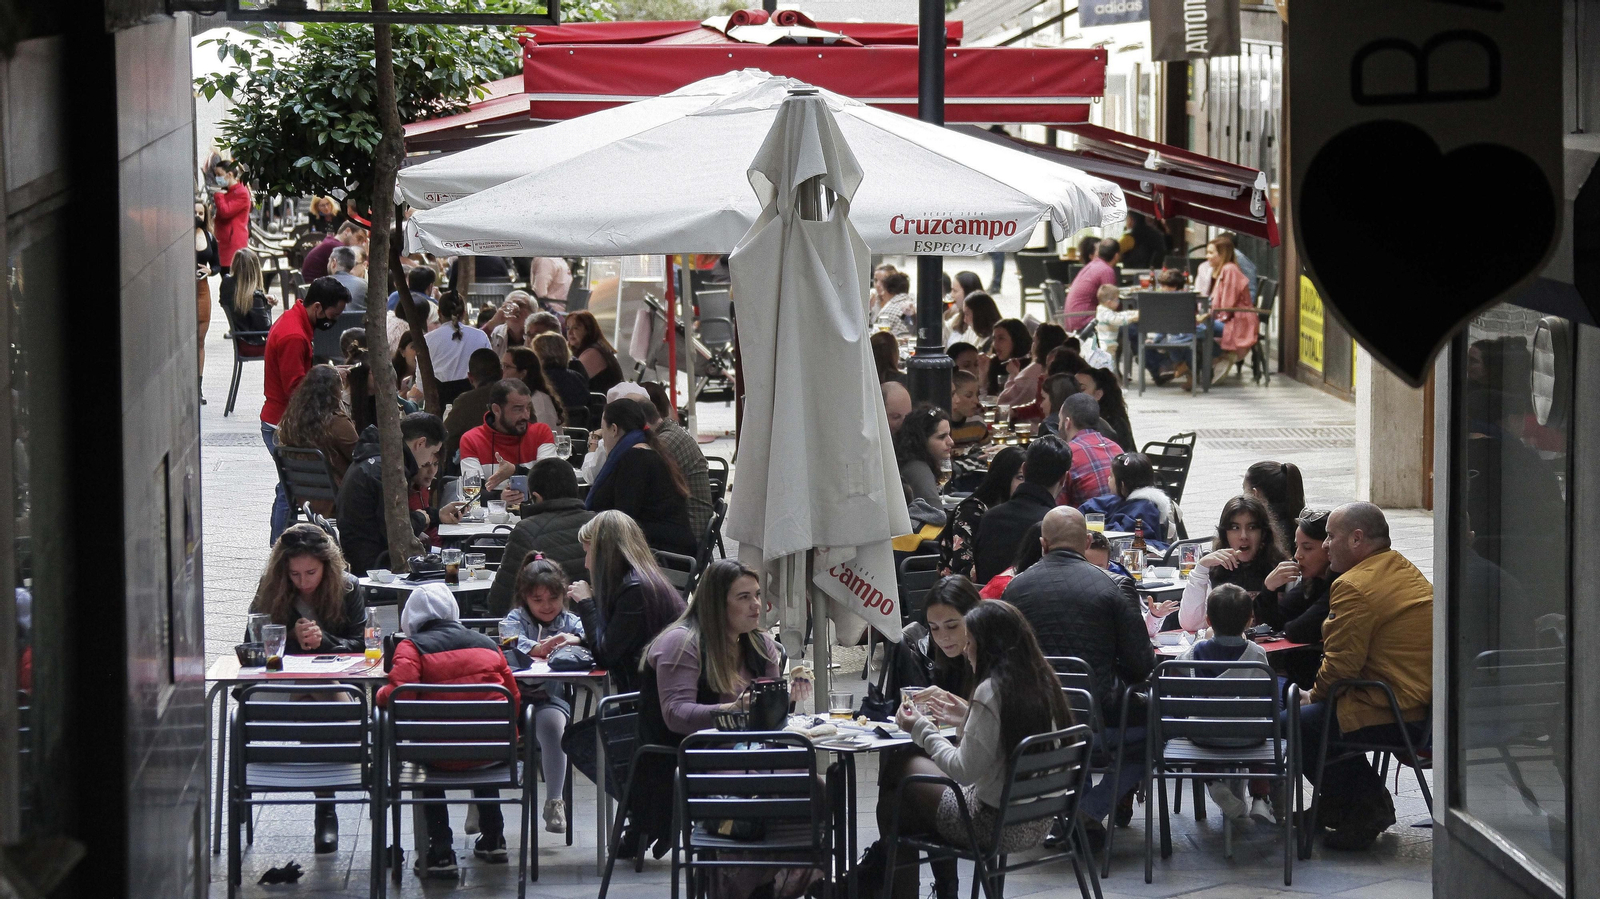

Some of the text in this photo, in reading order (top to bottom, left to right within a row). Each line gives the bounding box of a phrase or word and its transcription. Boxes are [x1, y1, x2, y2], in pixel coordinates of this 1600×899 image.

[1094, 0, 1143, 15] adidas
[890, 214, 1017, 240] Cruzcampo
[913, 240, 984, 253] ESPECIAL
